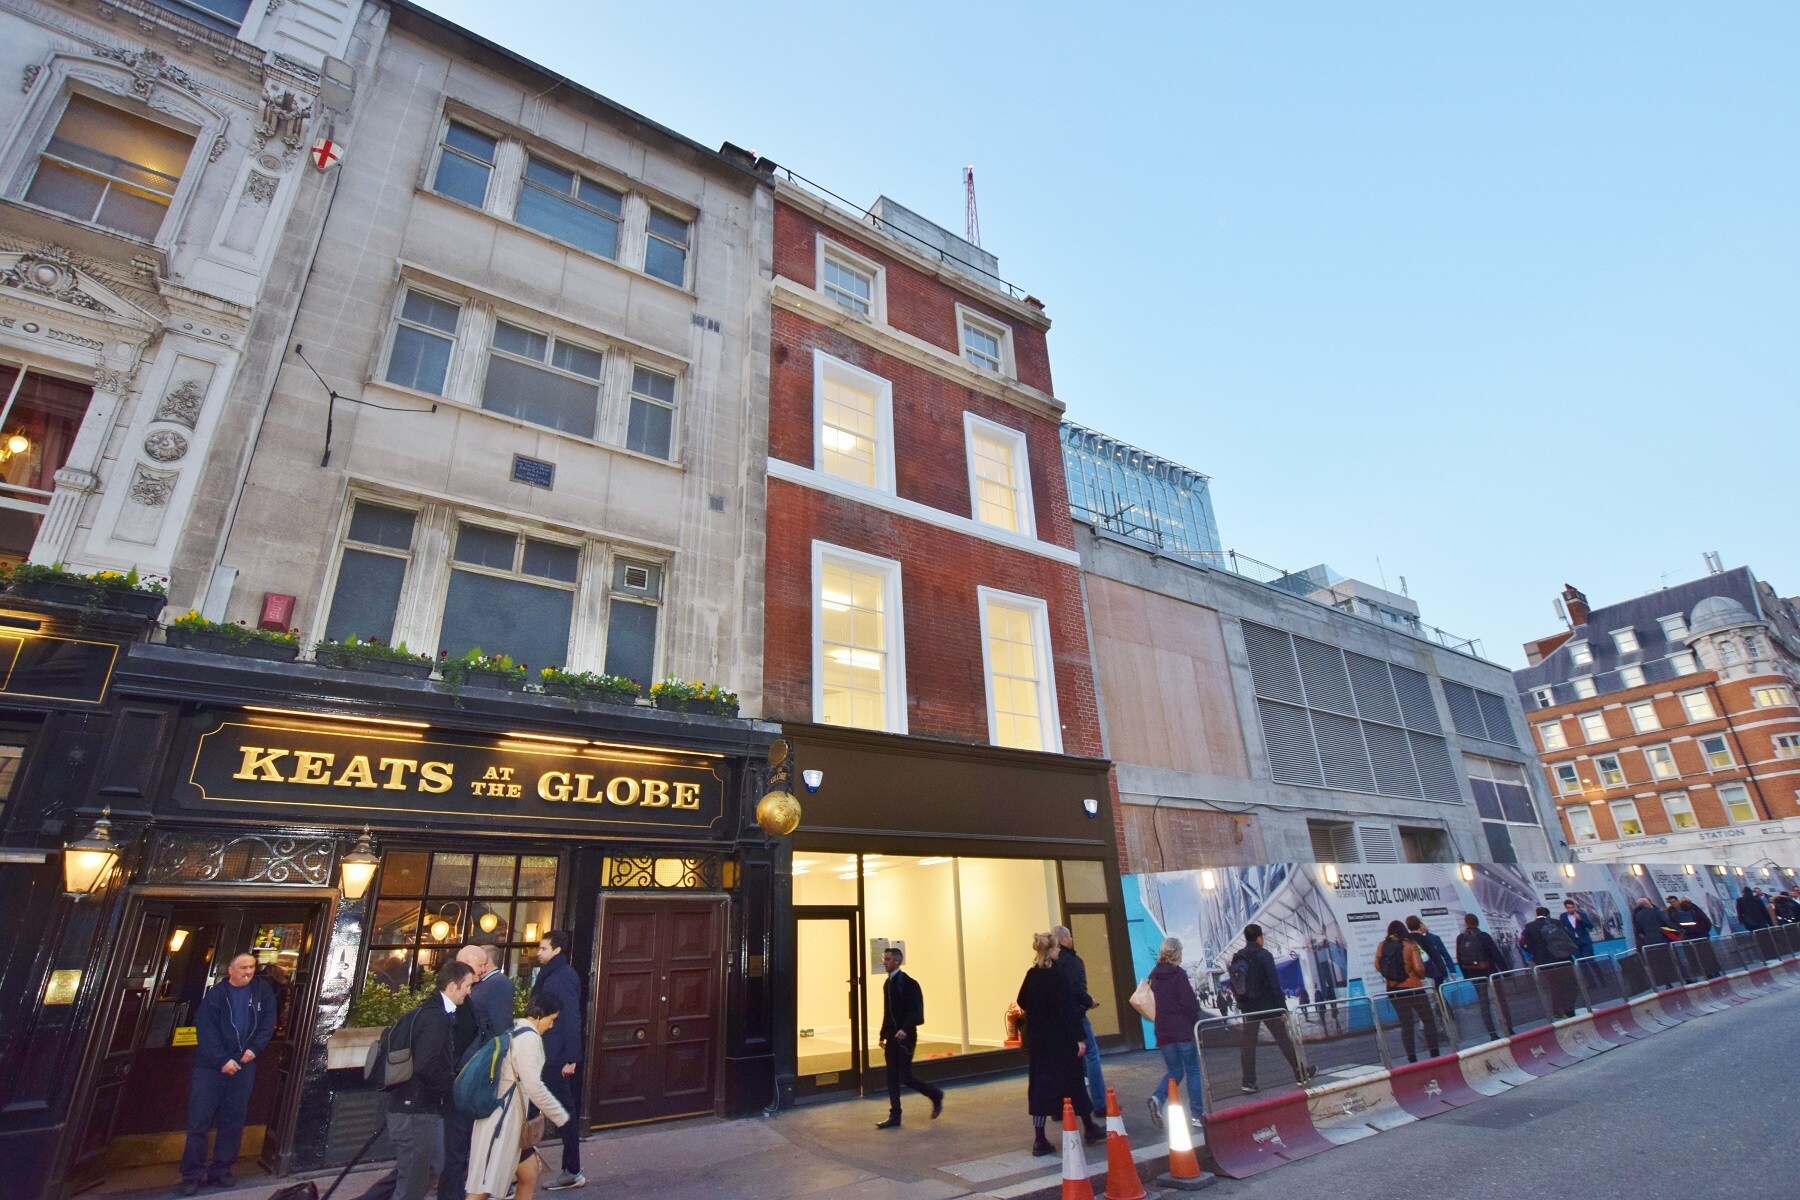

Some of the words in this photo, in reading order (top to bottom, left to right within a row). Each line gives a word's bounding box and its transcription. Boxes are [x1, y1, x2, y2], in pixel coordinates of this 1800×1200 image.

[232, 745, 456, 795] KEATS
[482, 766, 515, 781] AT
[471, 781, 522, 799] THE
[537, 770, 701, 810] GLOBE
[1616, 837, 1668, 850] UNDERGROUND
[1698, 828, 1746, 841] STATION
[1334, 873, 1377, 889] DESIGNED
[1364, 888, 1393, 905] LOCAL
[1392, 886, 1441, 903] COMMUNITY
